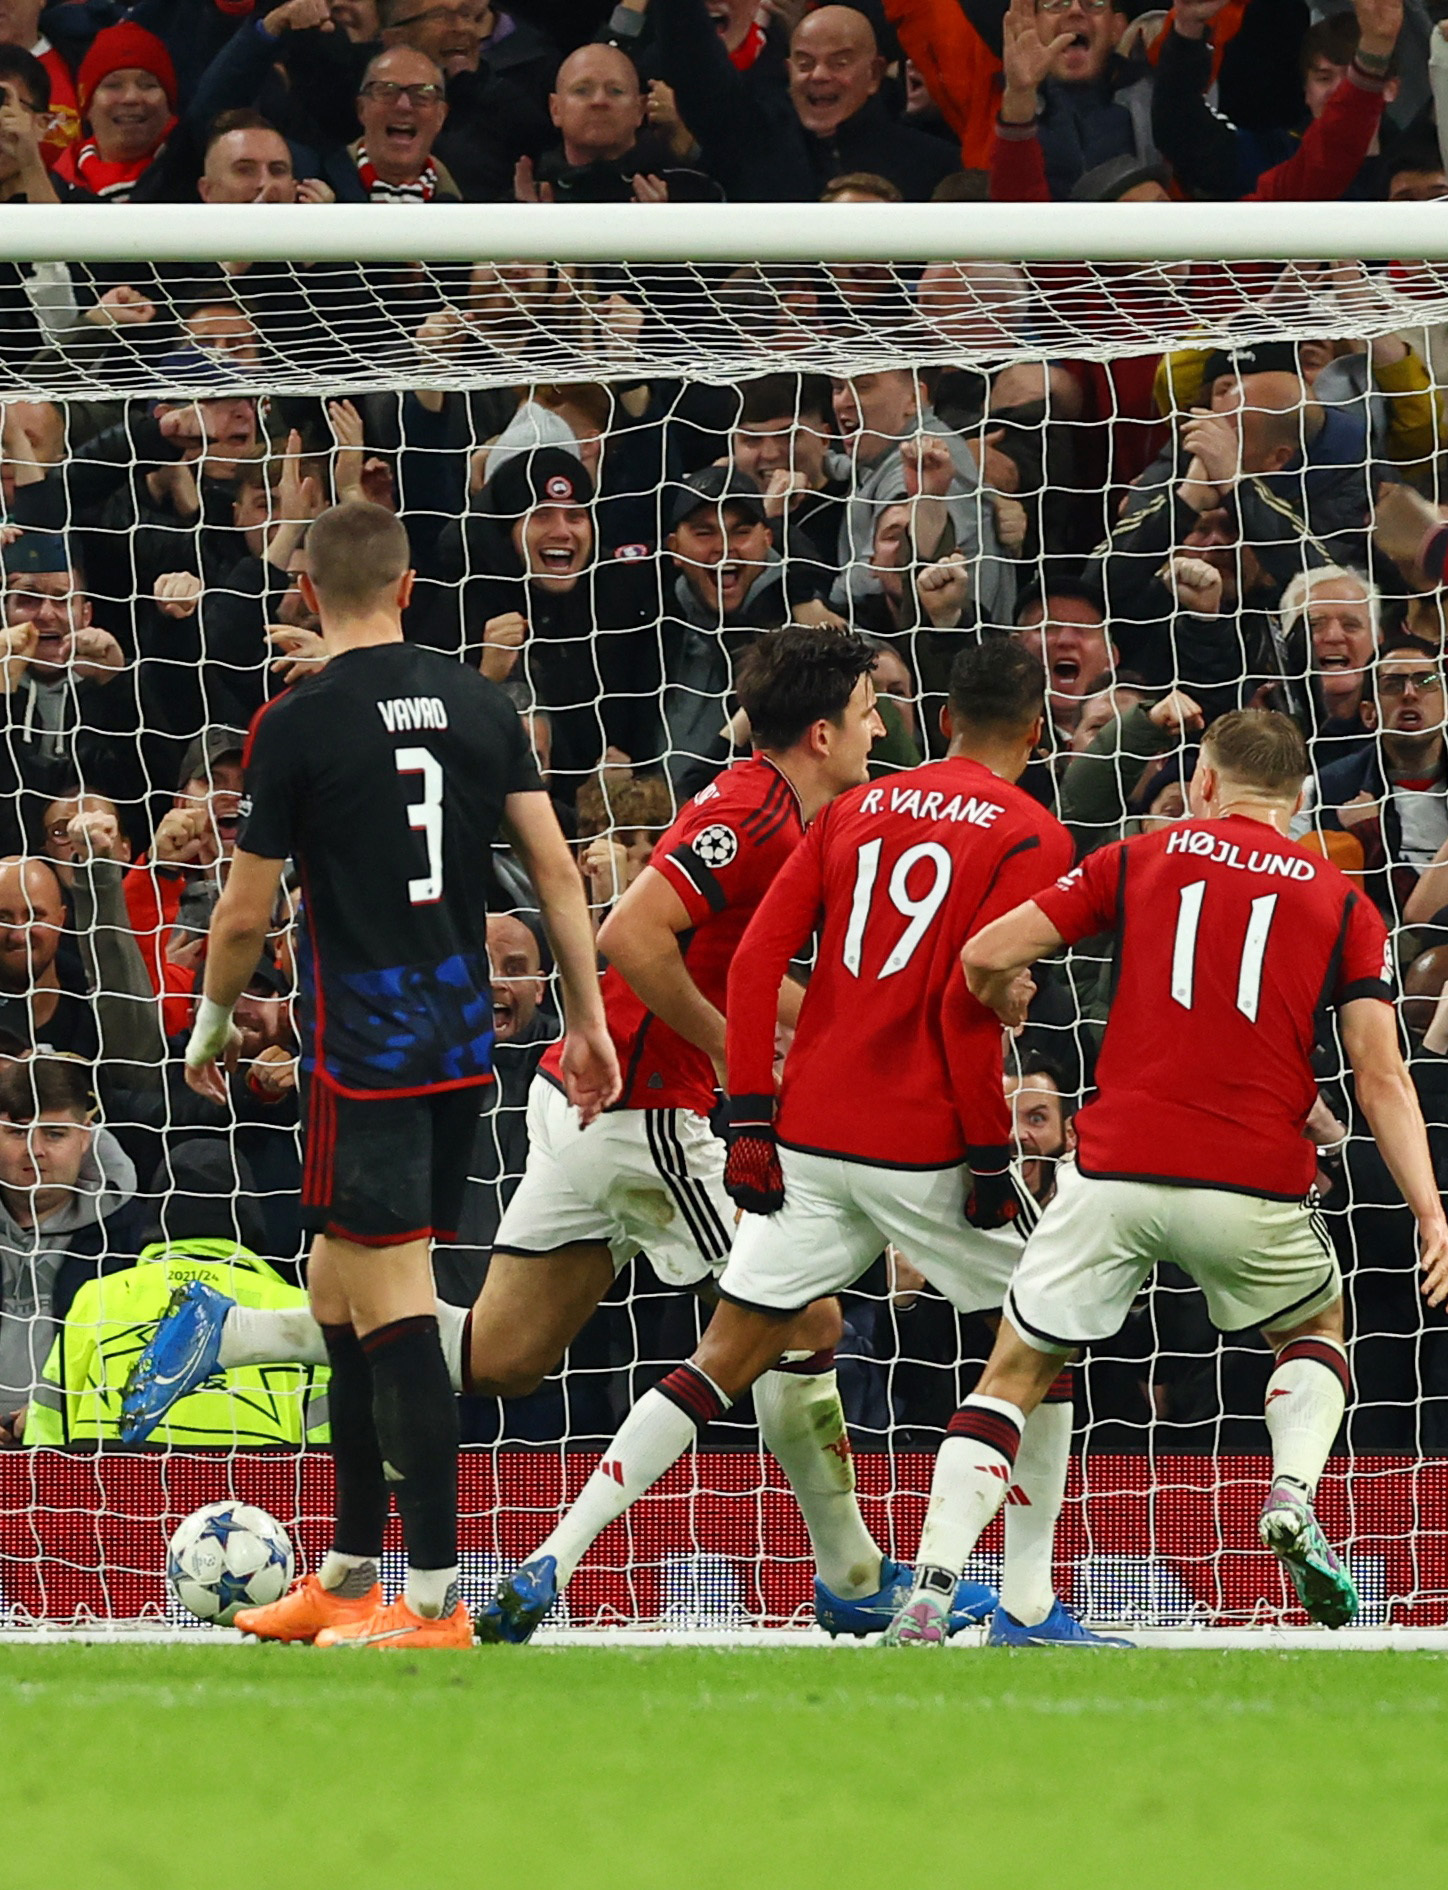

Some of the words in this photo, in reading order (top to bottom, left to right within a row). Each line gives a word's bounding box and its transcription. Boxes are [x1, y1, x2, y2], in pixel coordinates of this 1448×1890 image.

[394, 746, 444, 906] 3
[1166, 829, 1316, 882] HØJLUND
[842, 836, 953, 981] 19
[1171, 879, 1279, 1024] 11
[168, 1269, 220, 1283] 2021/24
